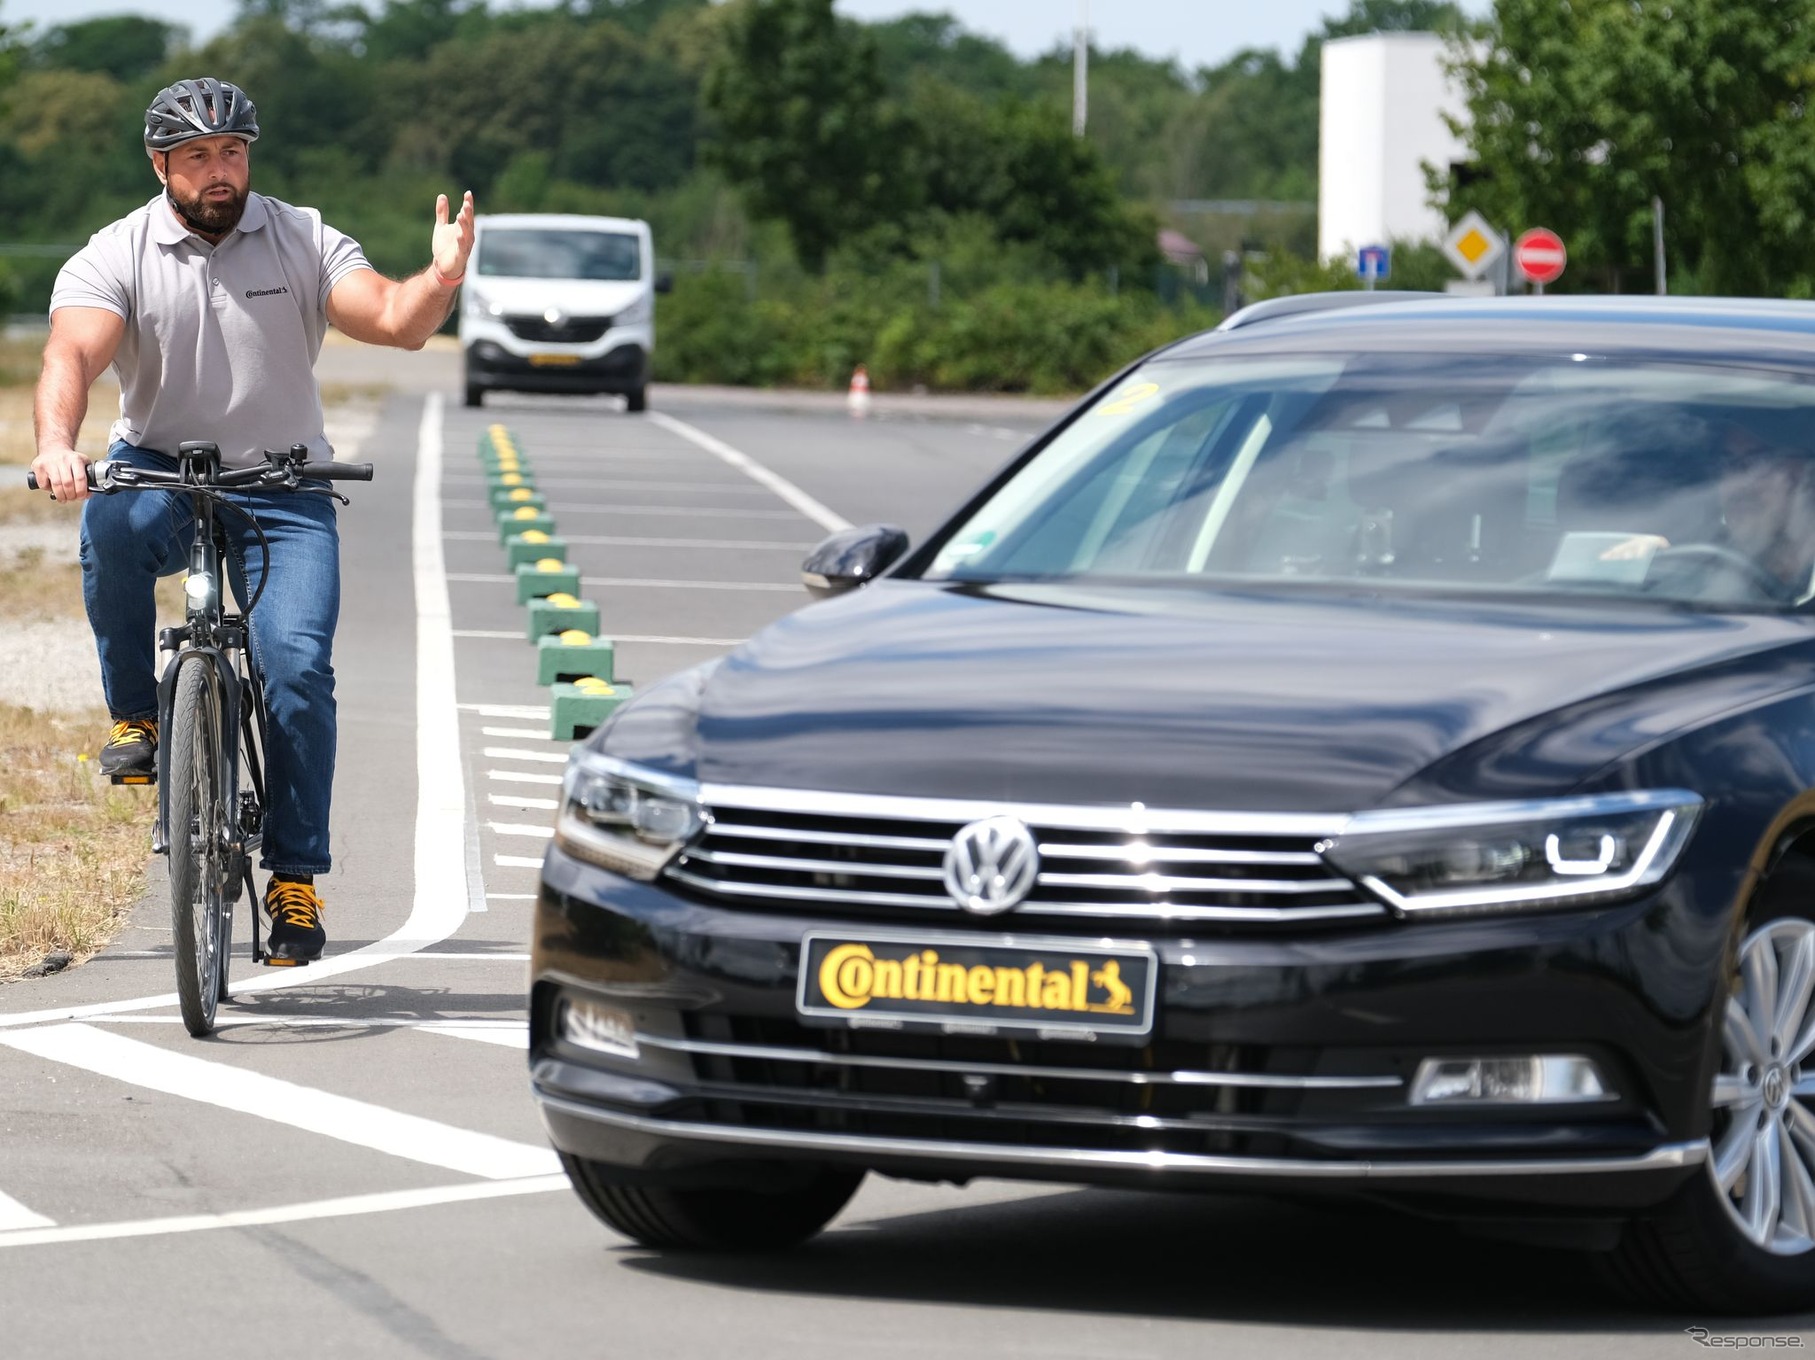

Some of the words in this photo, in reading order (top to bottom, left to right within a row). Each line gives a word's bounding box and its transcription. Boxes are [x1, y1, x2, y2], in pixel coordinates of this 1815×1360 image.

[245, 287, 283, 299] Continental
[1097, 382, 1159, 416] 2
[818, 943, 1090, 1012] Continental
